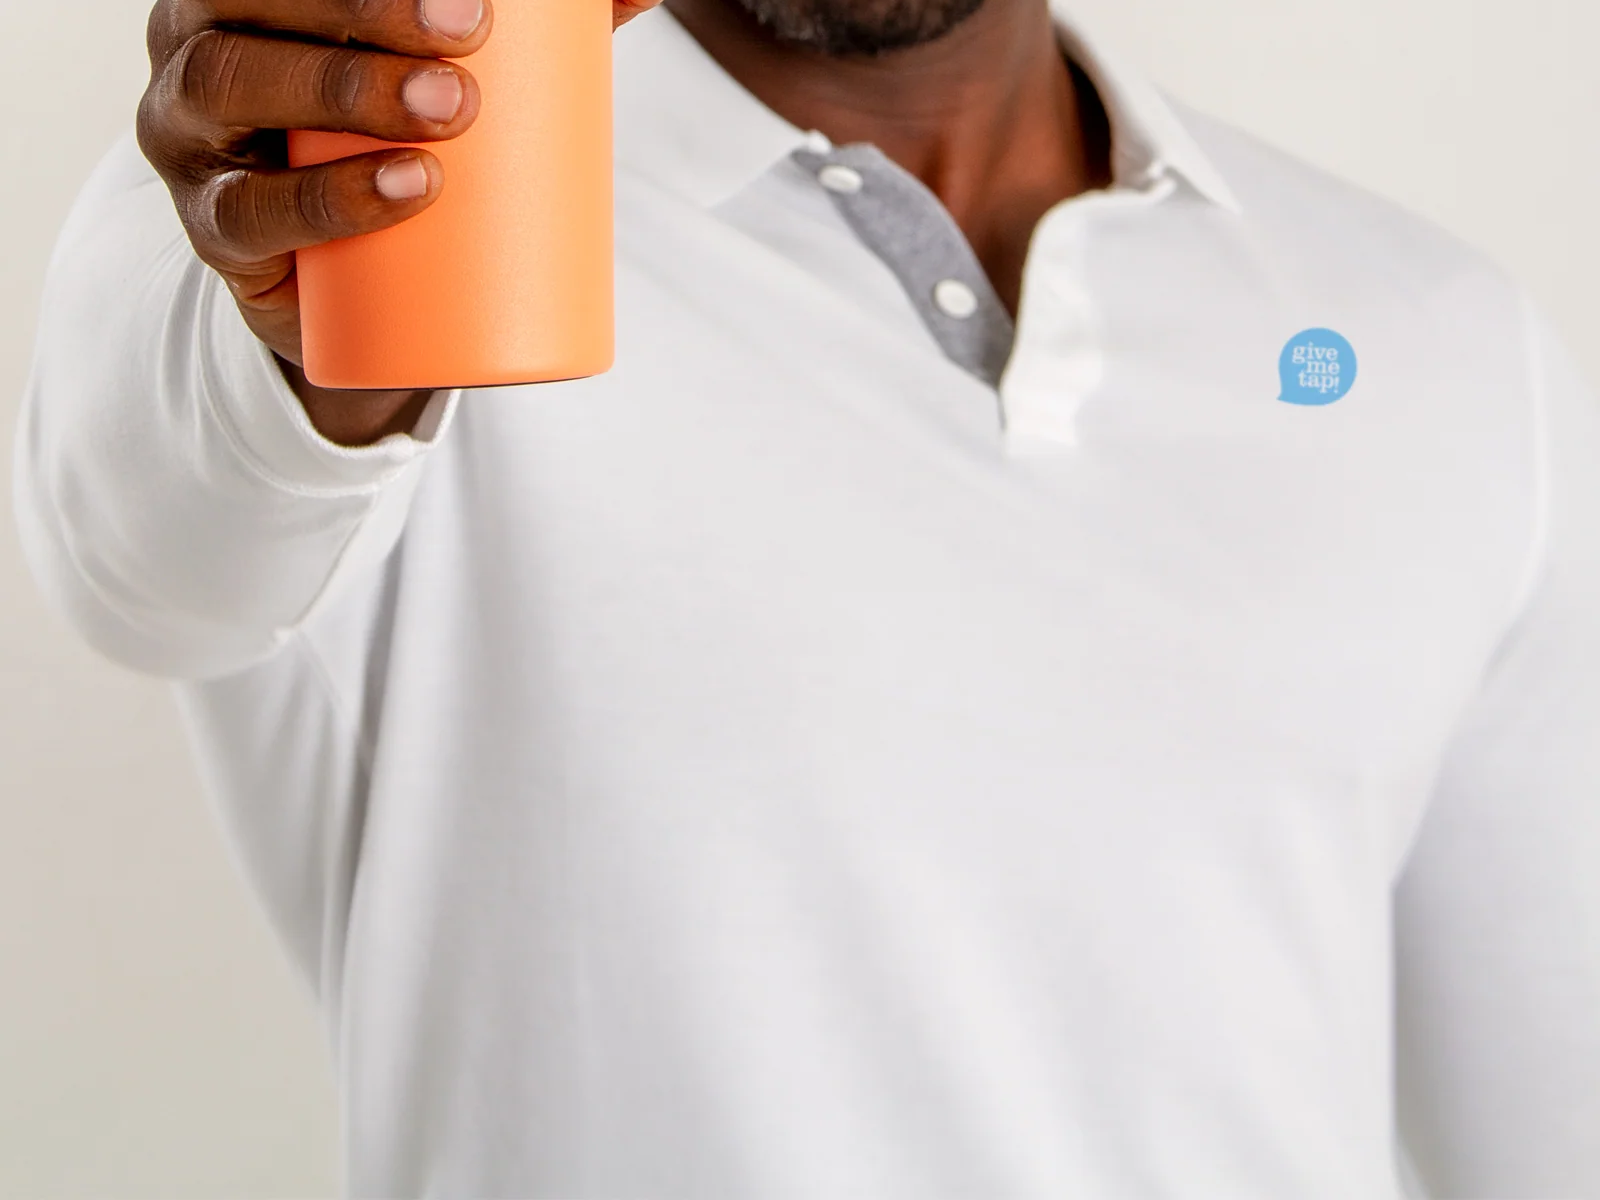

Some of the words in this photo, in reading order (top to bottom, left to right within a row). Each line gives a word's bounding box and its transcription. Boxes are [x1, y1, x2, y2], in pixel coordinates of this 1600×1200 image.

[1292, 342, 1338, 363] give
[1306, 360, 1340, 374] me
[1298, 370, 1339, 393] tap!
